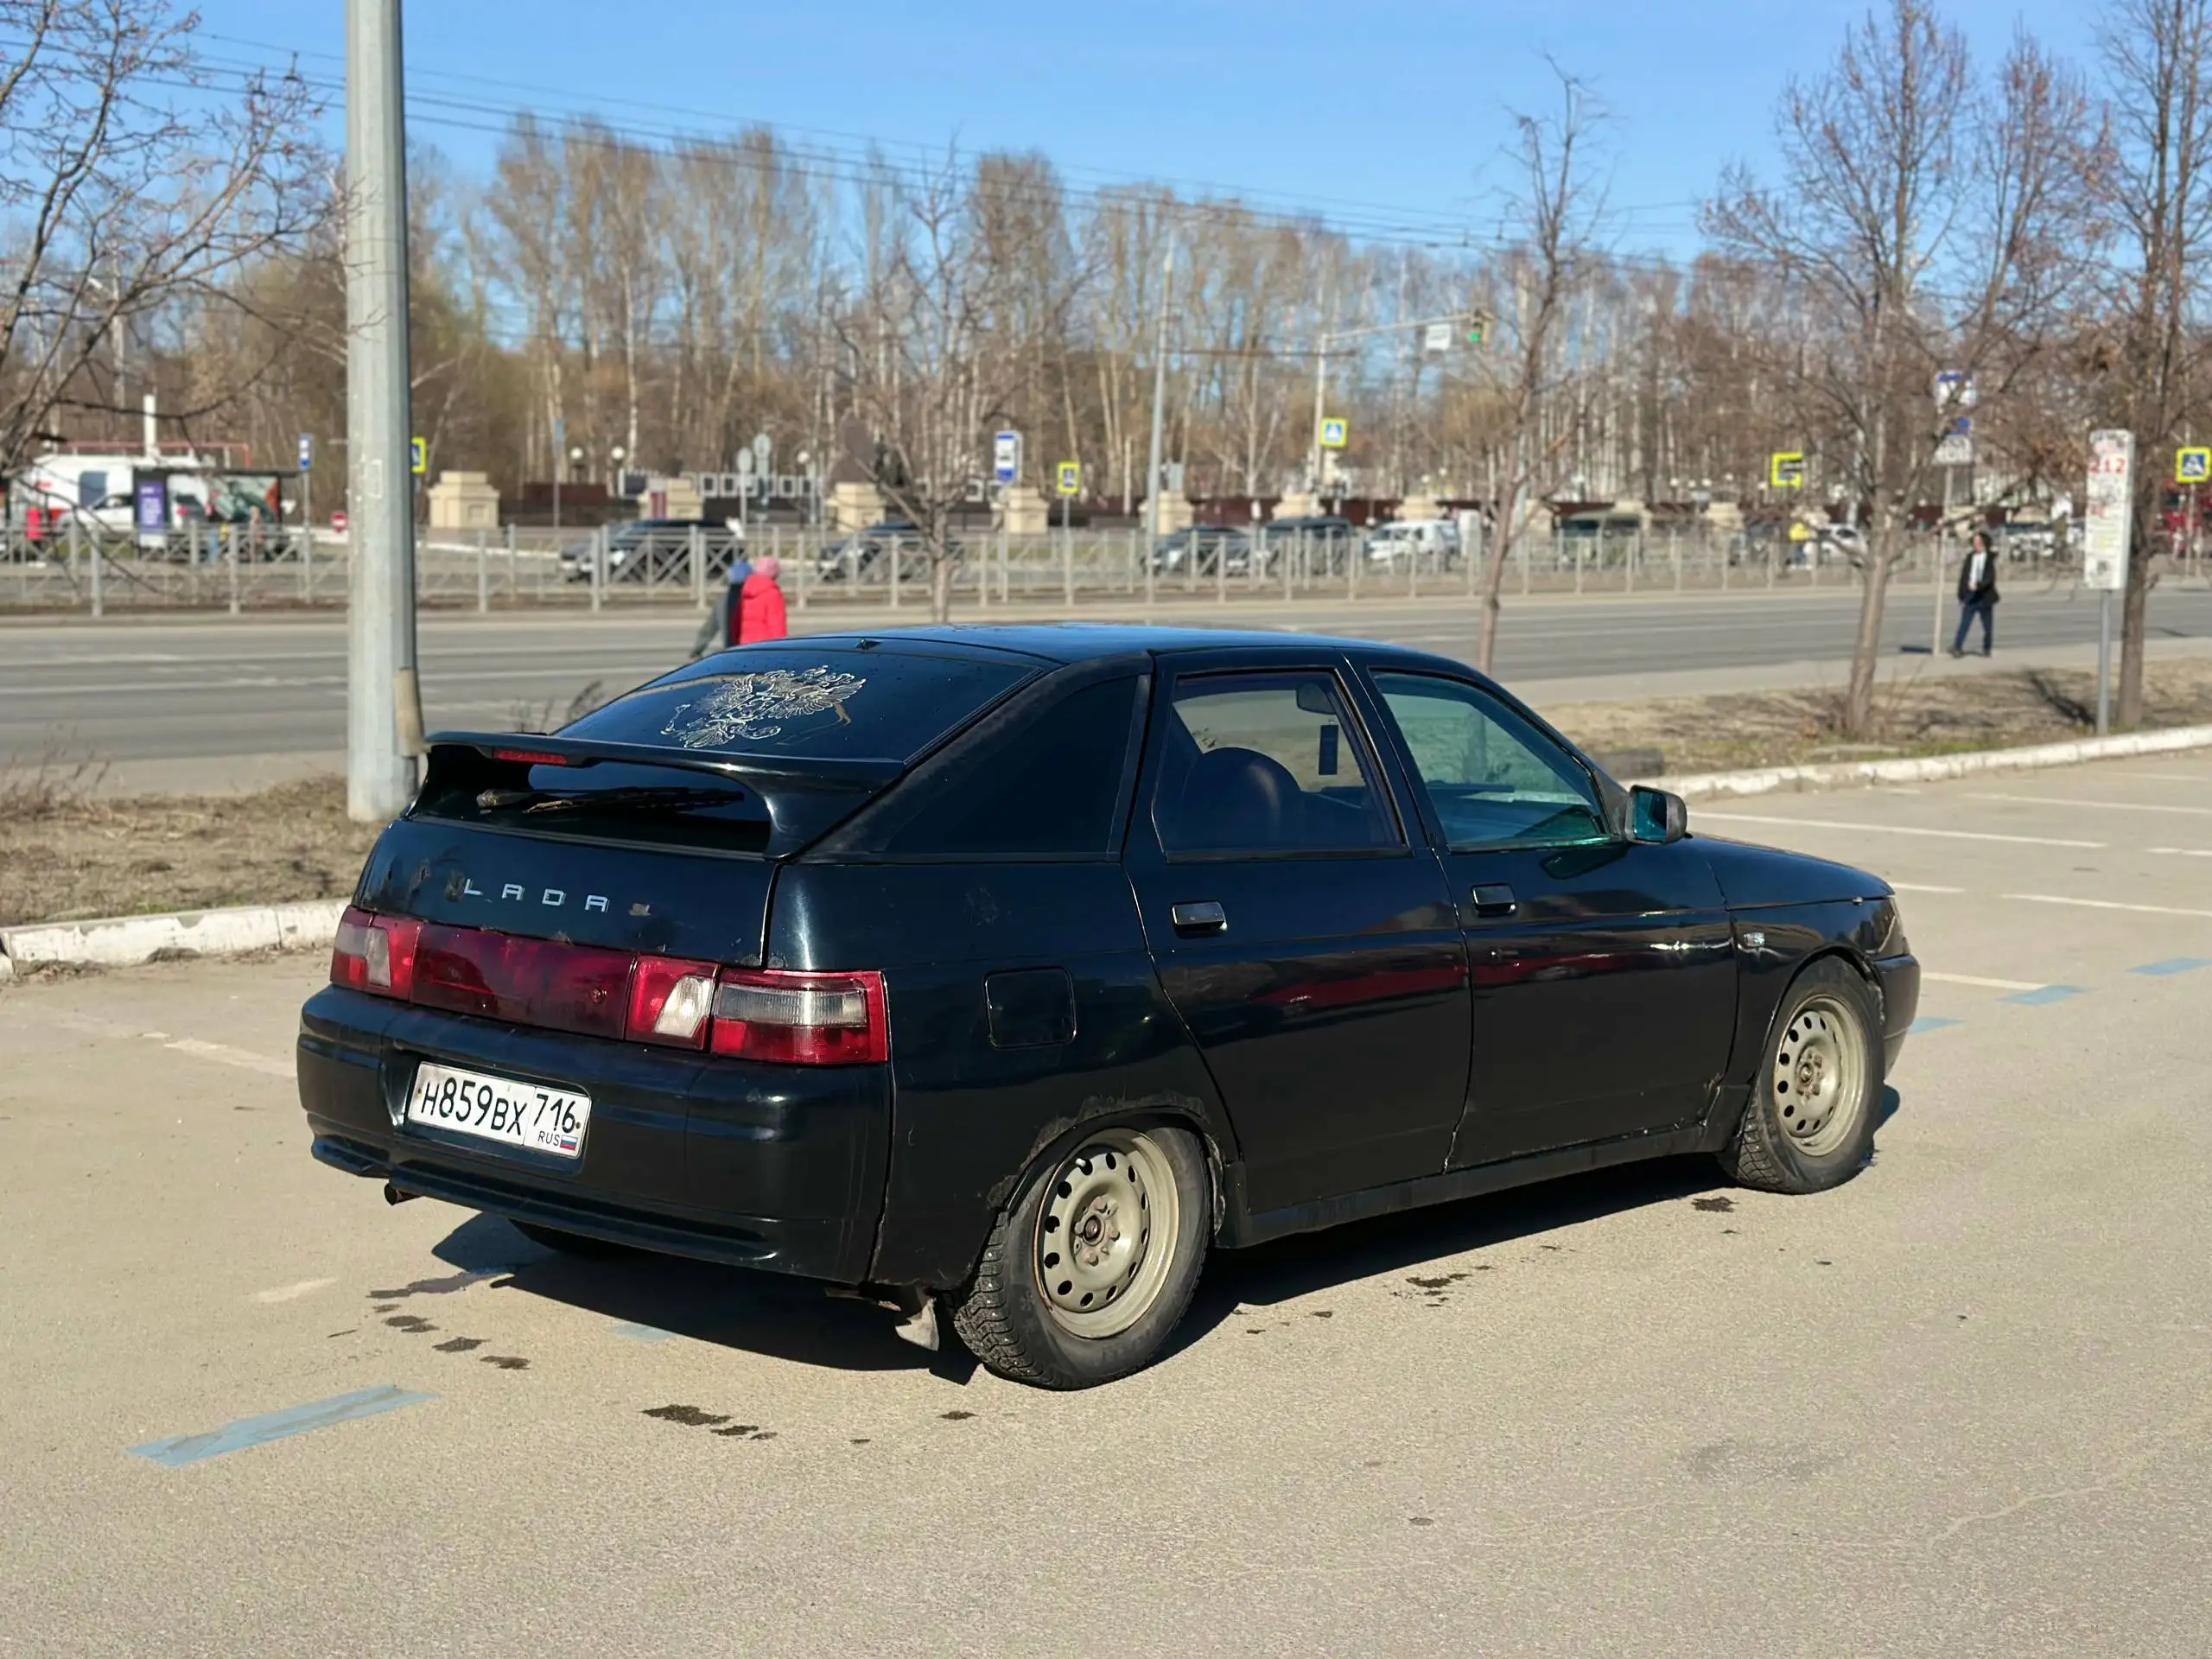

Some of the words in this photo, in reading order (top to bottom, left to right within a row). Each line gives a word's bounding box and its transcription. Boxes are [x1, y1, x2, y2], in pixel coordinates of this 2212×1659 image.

[464, 878, 608, 912] LADA
[533, 1093, 575, 1134] 716
[537, 1130, 560, 1147] RUS
